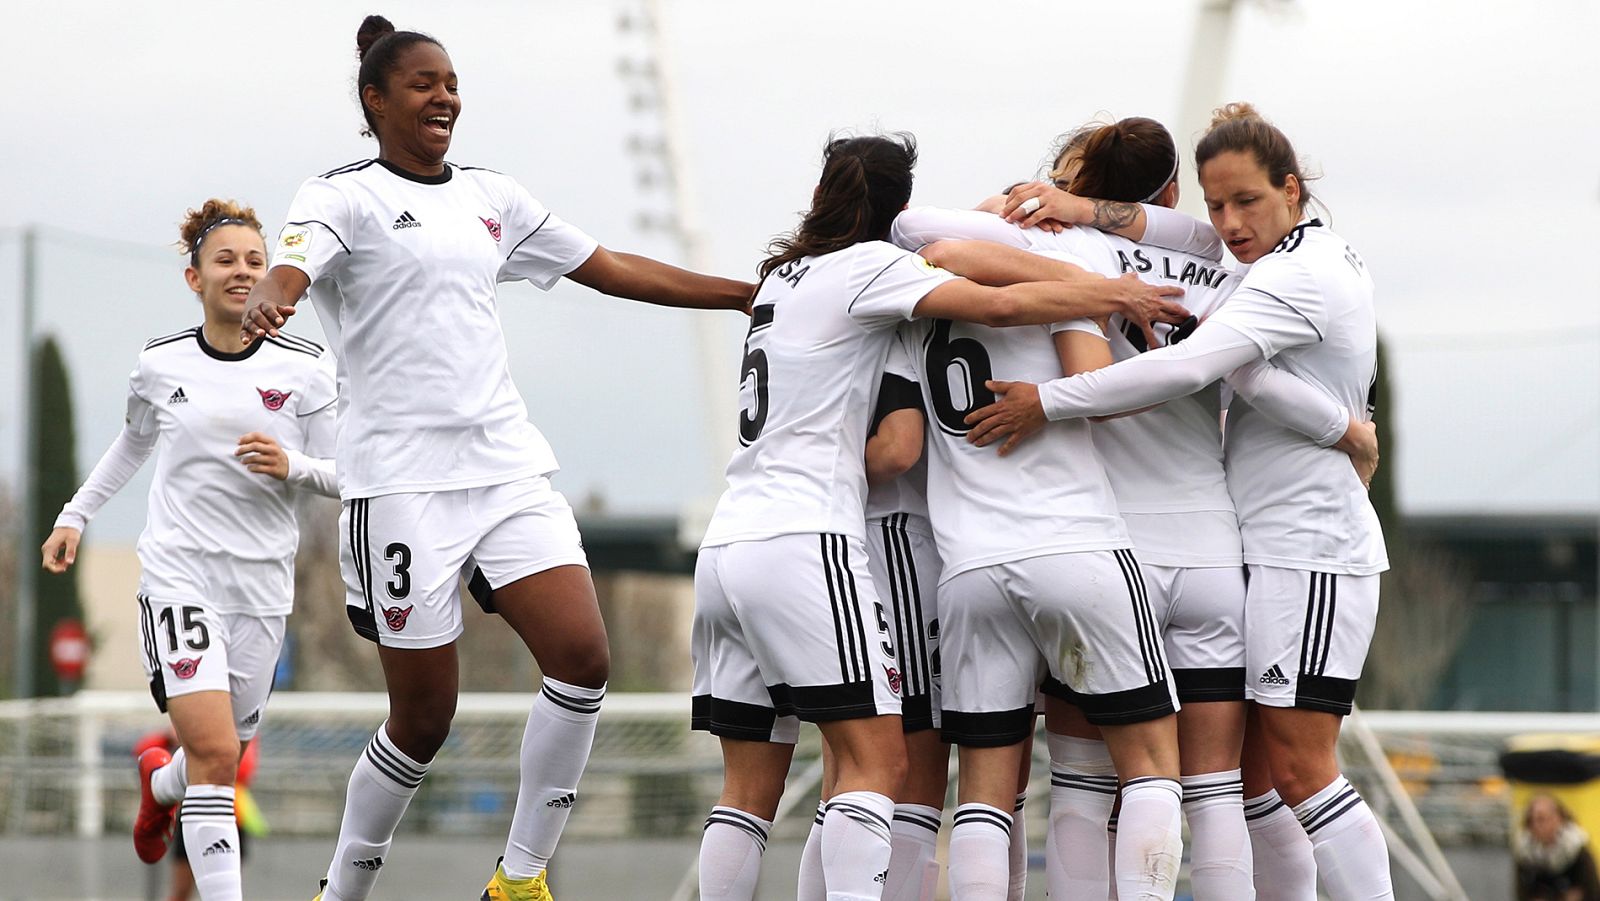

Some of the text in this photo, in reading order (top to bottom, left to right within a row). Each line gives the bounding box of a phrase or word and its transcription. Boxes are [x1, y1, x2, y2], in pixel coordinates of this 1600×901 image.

[393, 221, 422, 231] adidas
[771, 257, 811, 289] SA
[1116, 248, 1229, 290] ASLANI
[738, 303, 776, 447] 5
[922, 318, 996, 437] 6
[384, 542, 412, 600] 3
[158, 605, 210, 654] 15
[873, 601, 896, 659] 5
[1260, 676, 1290, 685] adidas
